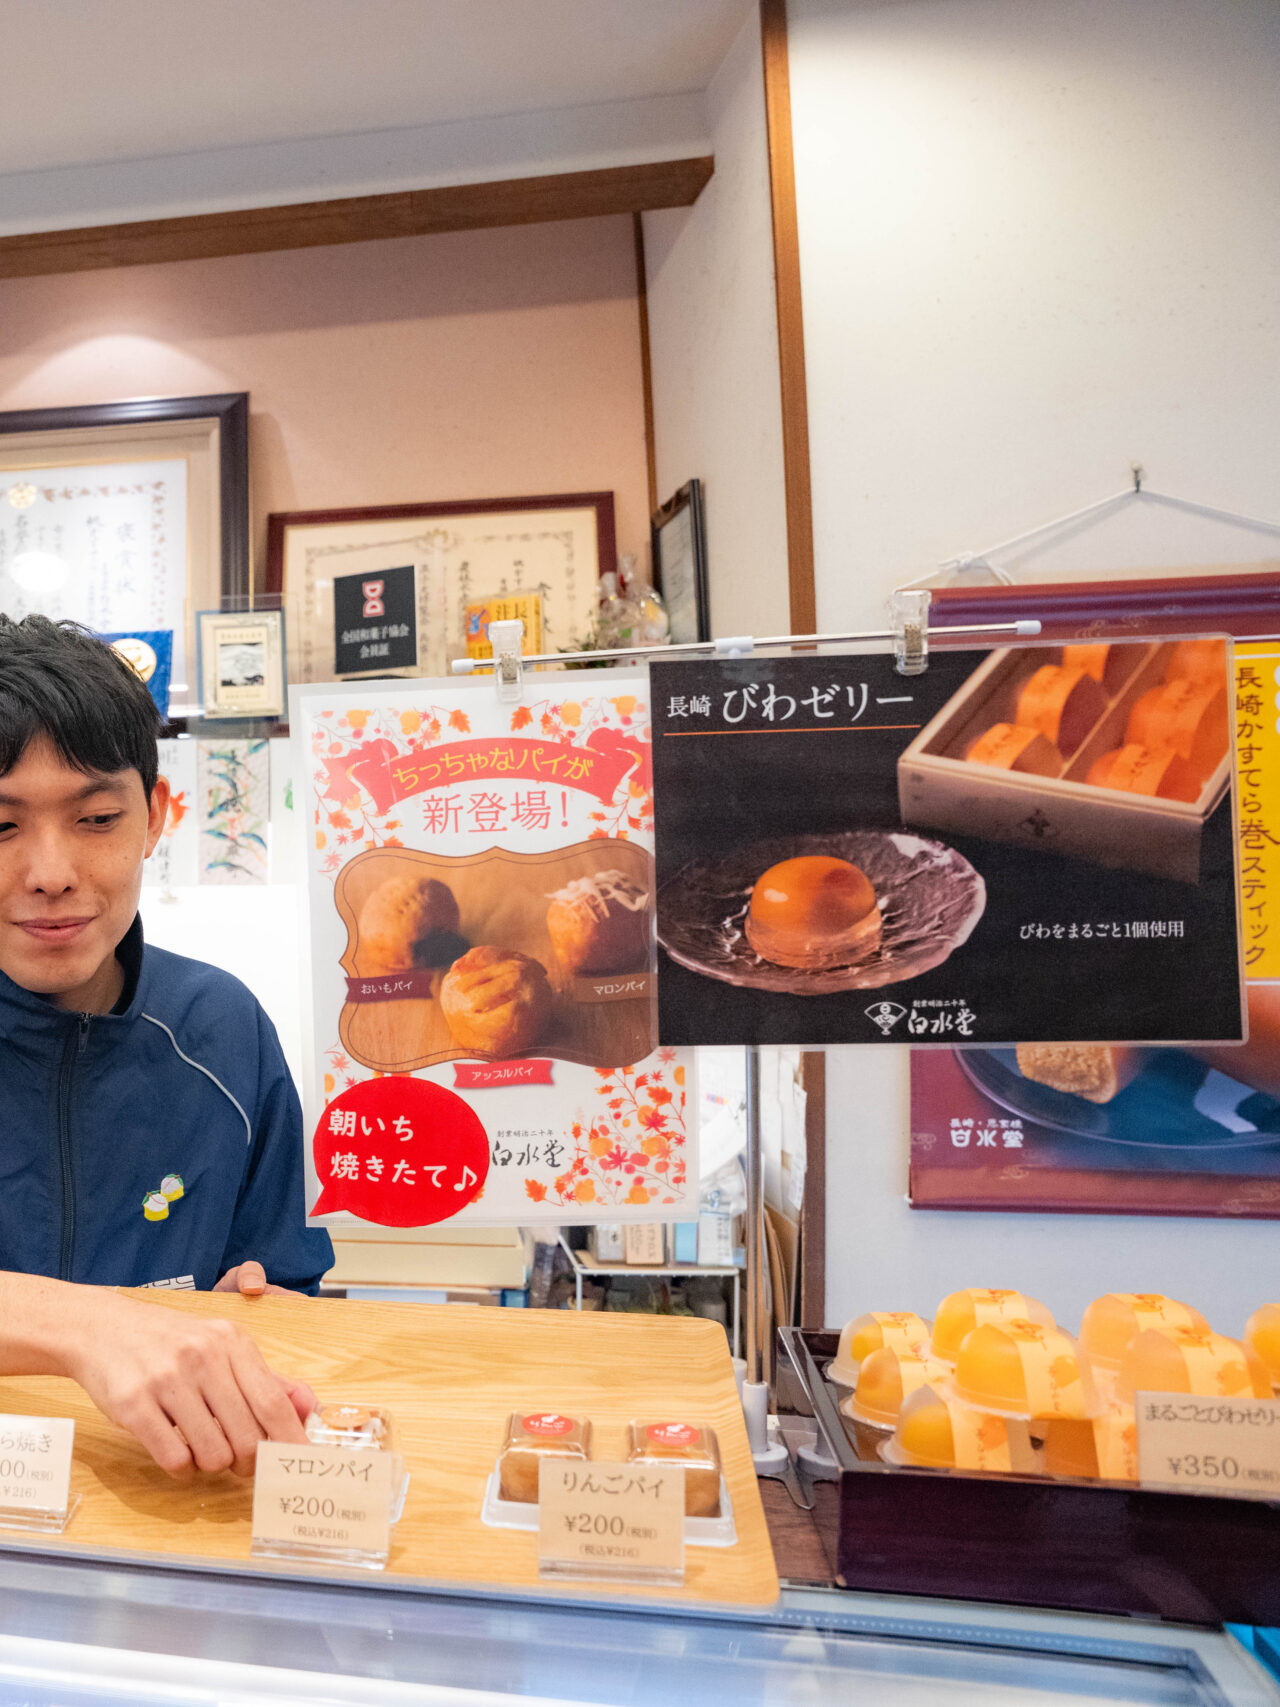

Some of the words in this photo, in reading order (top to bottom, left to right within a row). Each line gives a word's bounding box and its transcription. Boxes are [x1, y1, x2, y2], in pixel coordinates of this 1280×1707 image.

[667, 694, 712, 718] 長崎
[722, 682, 914, 723] びわゼリー
[392, 747, 594, 791] ちっちゃなパイが
[423, 789, 568, 834] 新登場!
[1235, 667, 1280, 966] 長崎かすてら巻スティック
[1020, 920, 1184, 940] びわをまるごと1個使用
[360, 980, 414, 995] おいもパイ
[593, 980, 647, 996] マロンパイ
[908, 1008, 976, 1035] 白水堂
[472, 1065, 535, 1081] アップルパイ
[328, 1108, 414, 1142] 朝いち
[497, 1129, 554, 1138] 創業明治二十年
[492, 1140, 565, 1168] 白水堂
[278, 1457, 374, 1482] マロンパイ
[563, 1472, 664, 1499] りんごパイ
